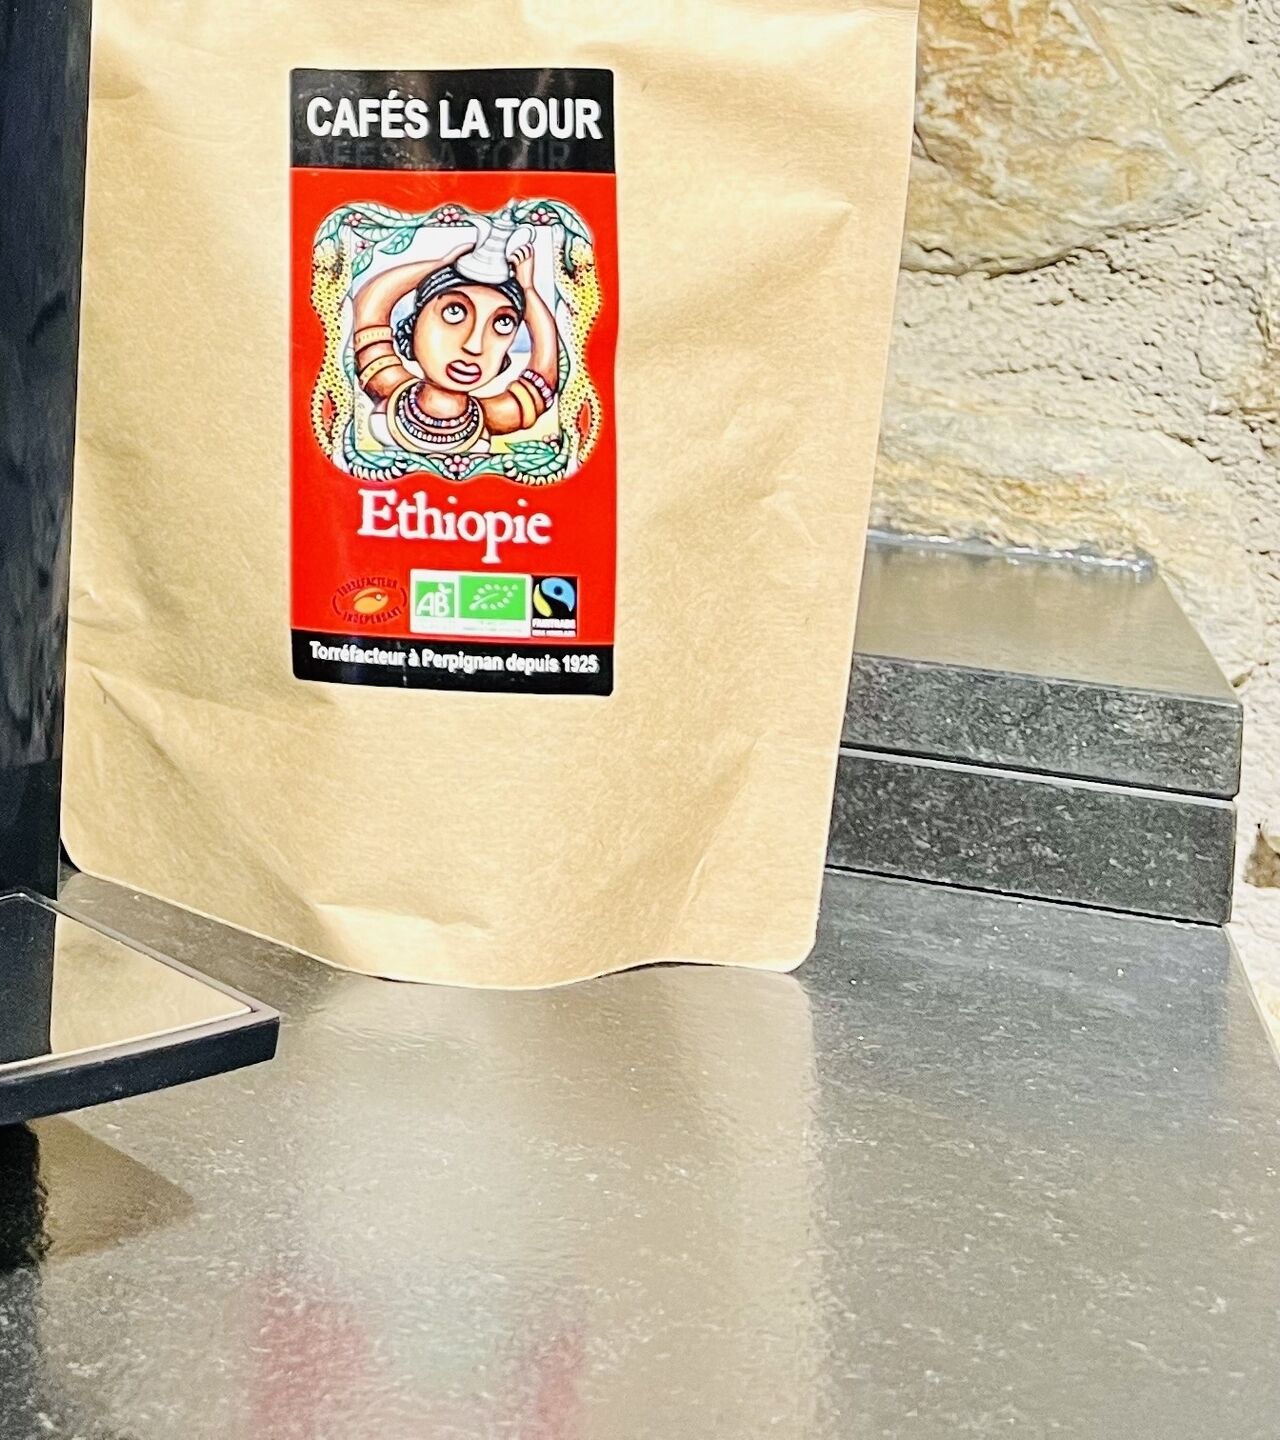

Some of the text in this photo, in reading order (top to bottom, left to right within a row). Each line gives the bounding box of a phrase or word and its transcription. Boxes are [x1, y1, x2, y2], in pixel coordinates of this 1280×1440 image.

[306, 90, 603, 140] CAFÉS LA TOUR
[357, 488, 553, 564] Ethiopie
[417, 591, 451, 617] AB
[309, 640, 600, 676] Torréfacteur à Perpignan depuis 1925
